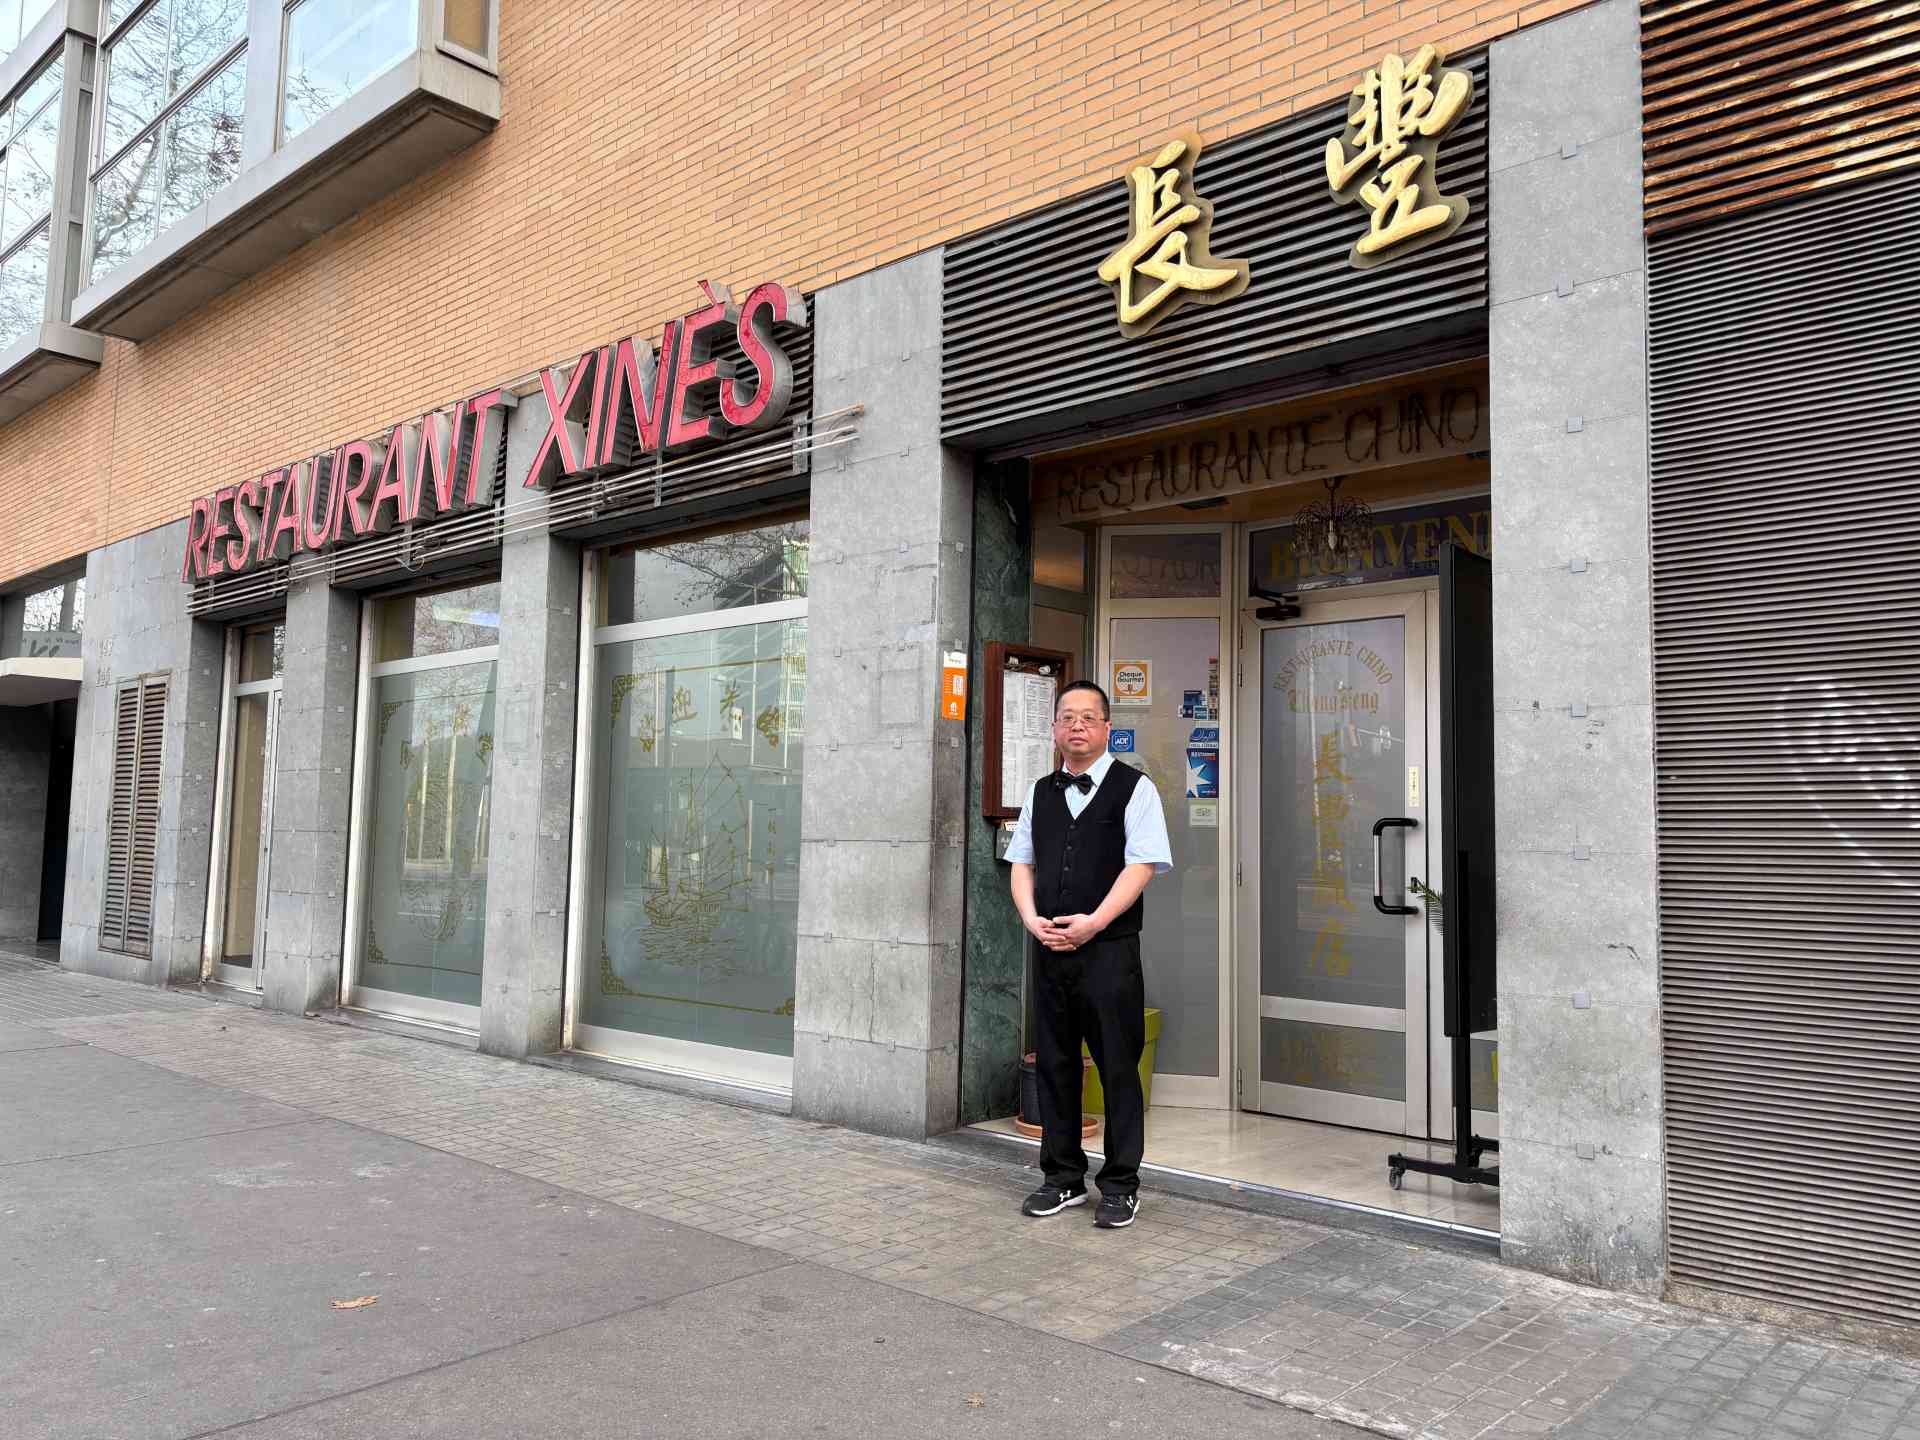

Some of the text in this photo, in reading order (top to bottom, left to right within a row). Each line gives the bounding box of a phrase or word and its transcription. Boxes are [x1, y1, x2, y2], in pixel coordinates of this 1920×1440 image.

[181, 280, 803, 584] RESTAURANT XINÈS
[1056, 386, 1480, 517] RESTAURANTE CHINO
[1271, 511, 1492, 577] BIENVEN
[1272, 639, 1354, 692] RESTAURANTE
[1356, 646, 1393, 686] CHINO
[1114, 736, 1129, 745] ADT
